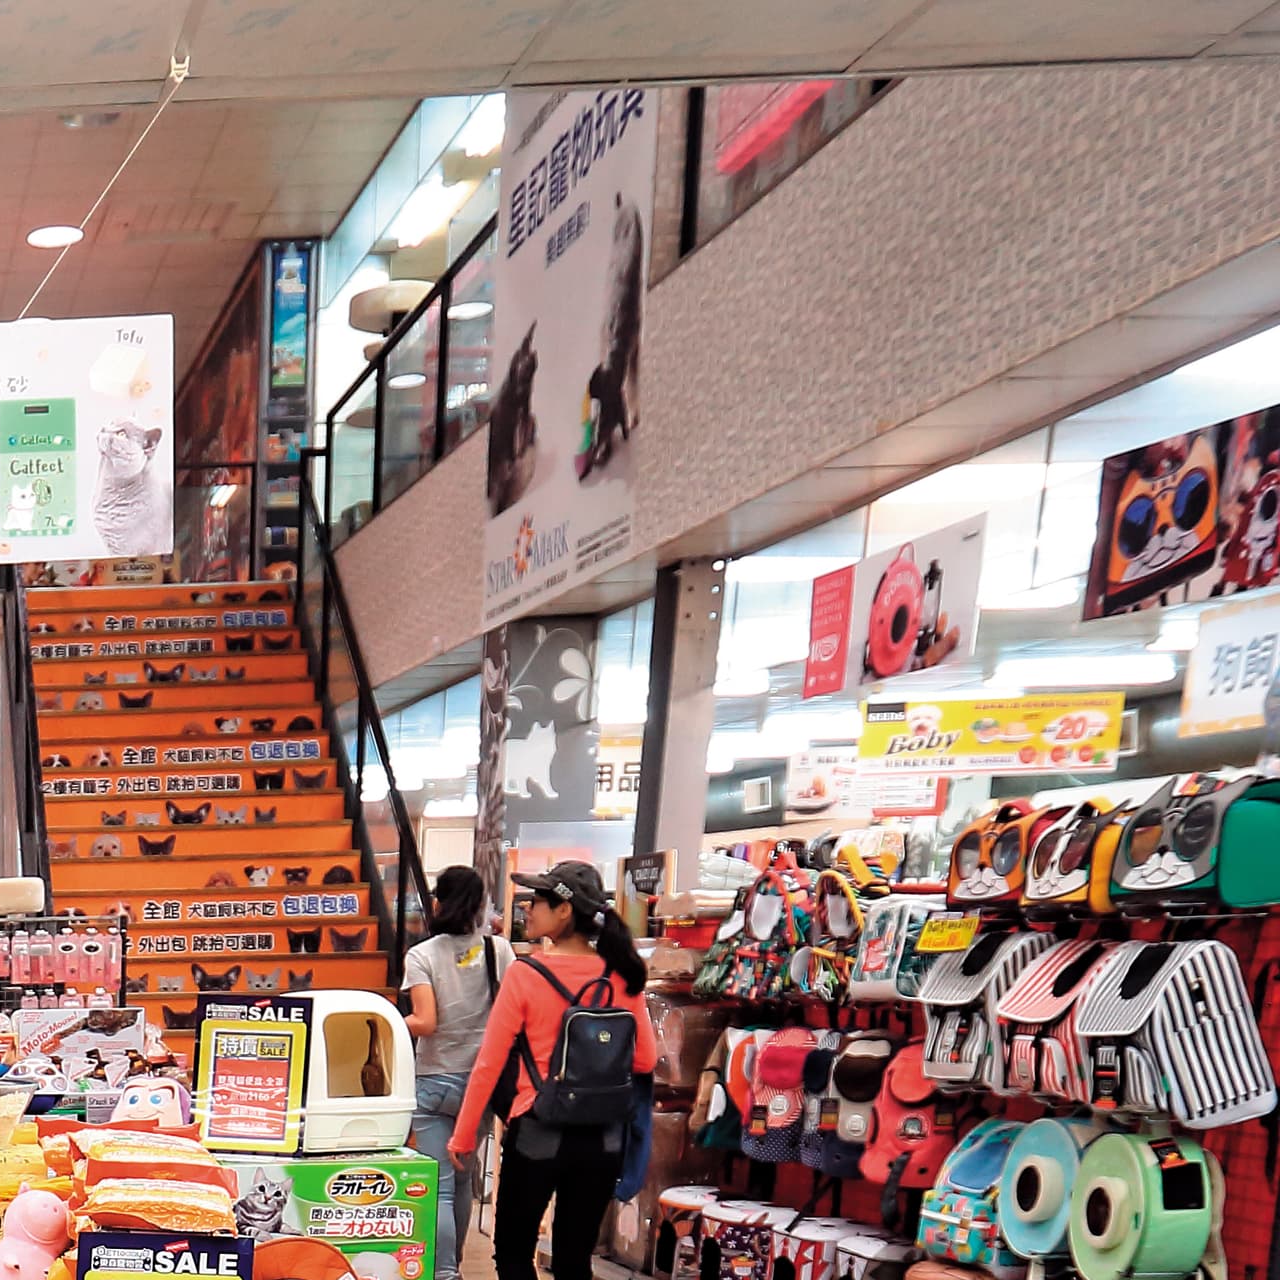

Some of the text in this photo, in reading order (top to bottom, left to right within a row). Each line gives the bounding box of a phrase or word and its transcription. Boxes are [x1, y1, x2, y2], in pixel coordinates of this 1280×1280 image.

[116, 328, 144, 345] Tofu
[9, 457, 65, 477] Catfeet
[1055, 716, 1091, 740] 20
[122, 739, 321, 766] 全館 犬貓飼料不吃 包退包換
[117, 775, 162, 793] 外出包
[143, 893, 361, 921] 全館 犬貓飼料不吃 包退包換
[138, 935, 188, 954] 外出包
[247, 1006, 305, 1023] SALE
[221, 1037, 259, 1056] 特價
[259, 1047, 286, 1057] SALE
[330, 1180, 393, 1196] デオトイレ
[154, 1251, 239, 1276] SALE
